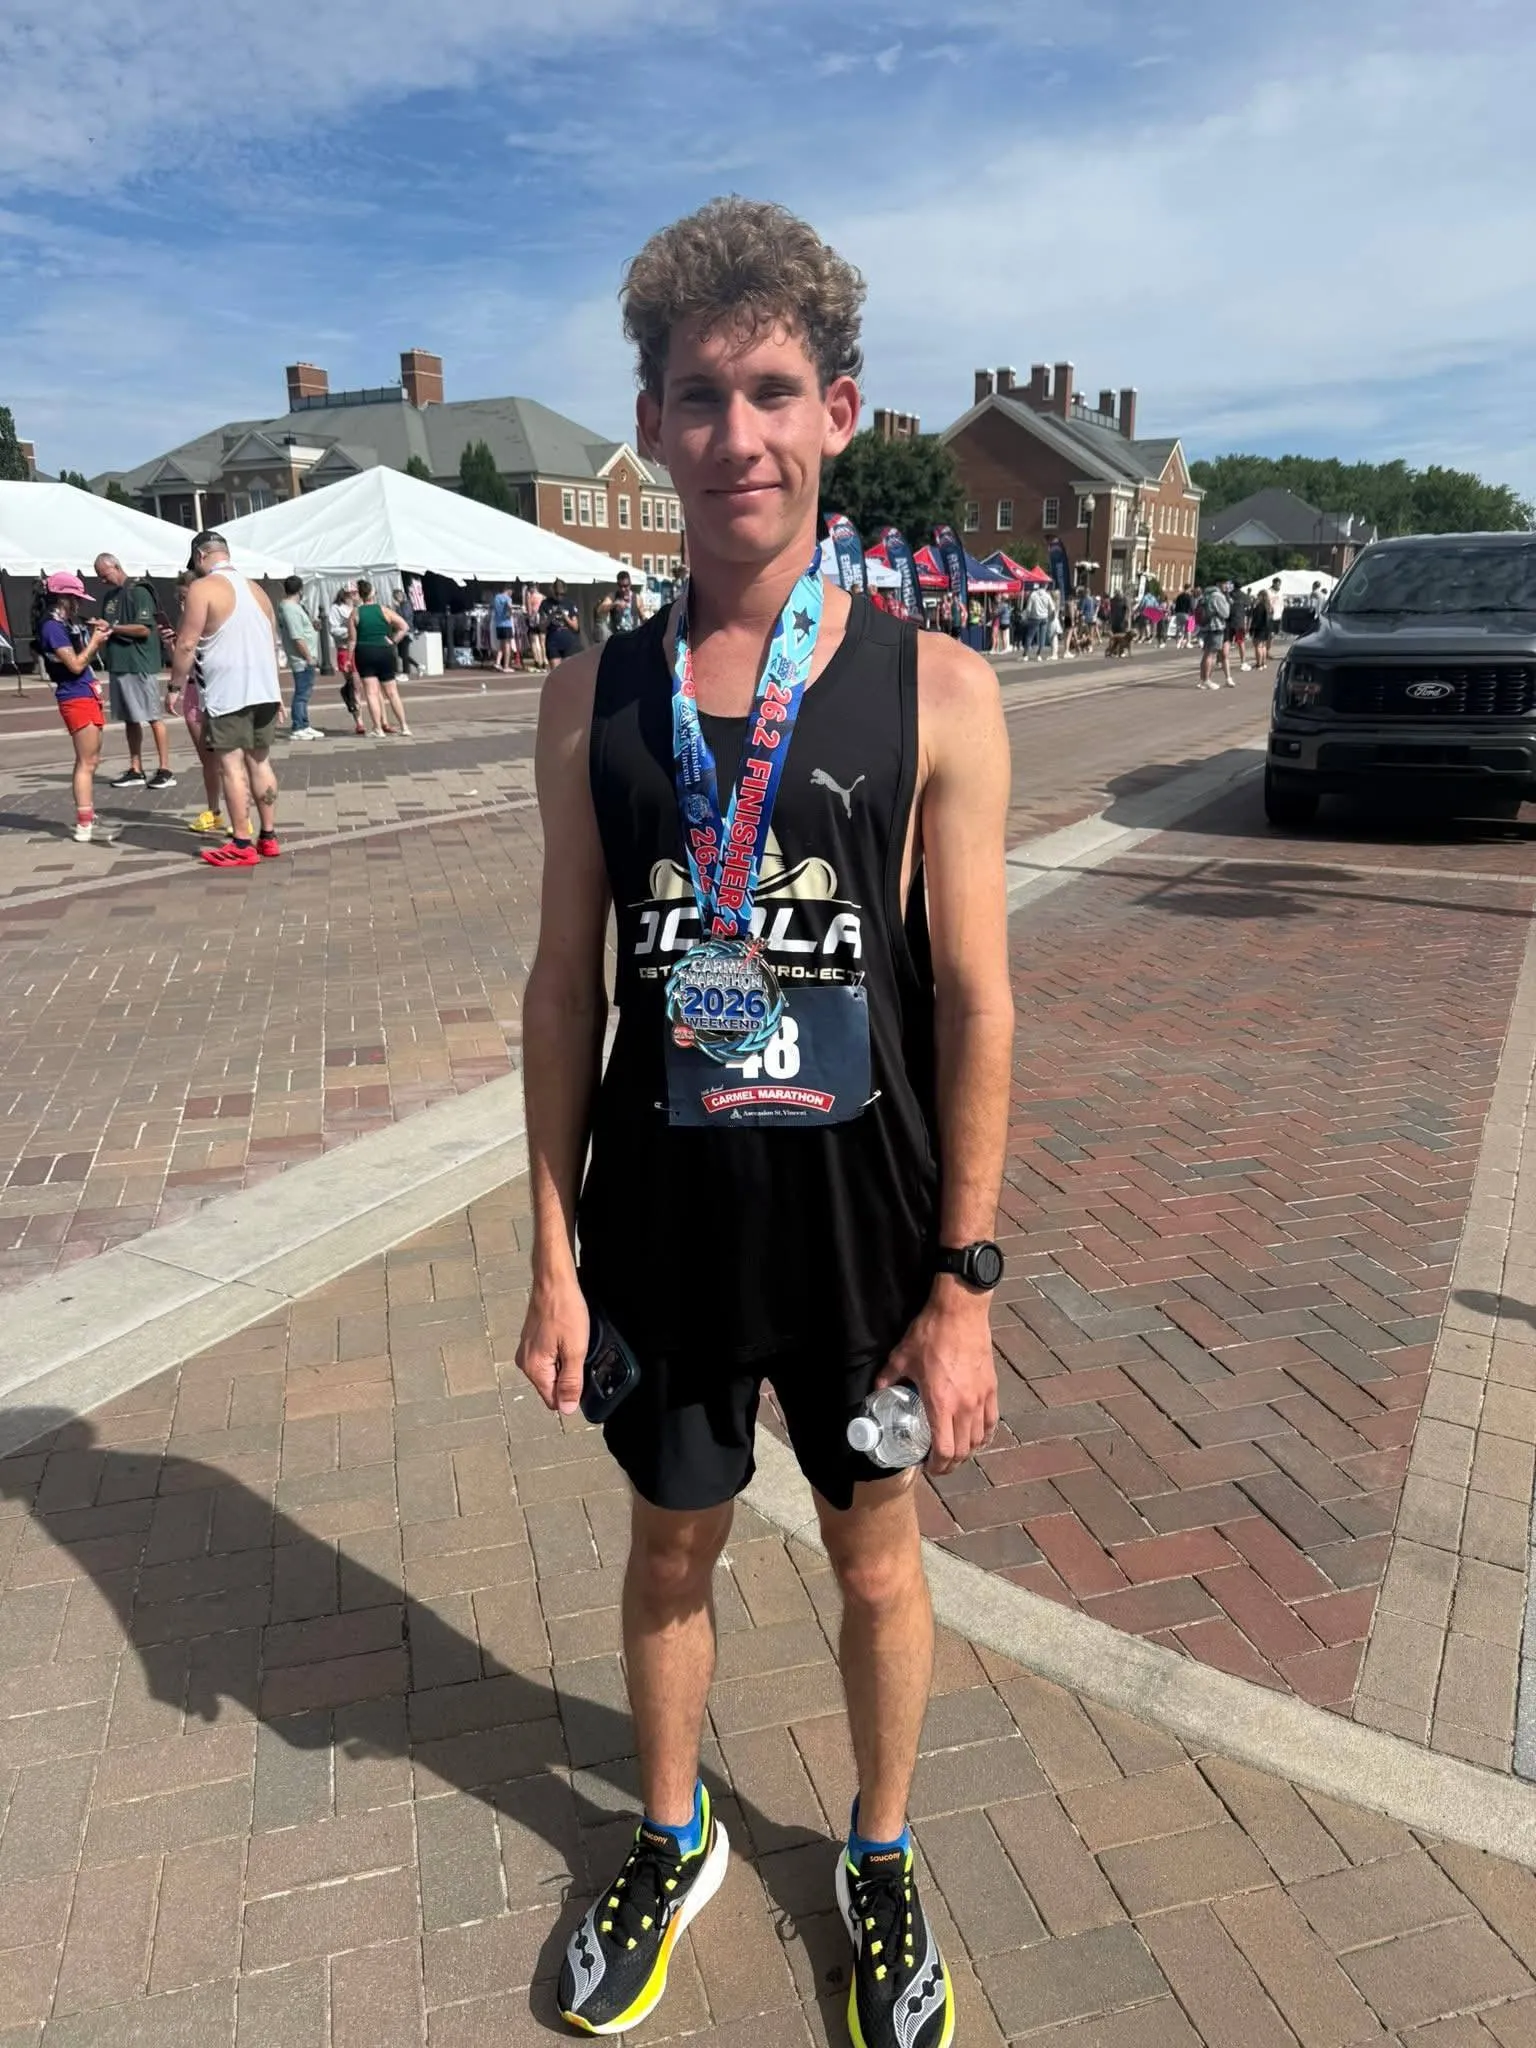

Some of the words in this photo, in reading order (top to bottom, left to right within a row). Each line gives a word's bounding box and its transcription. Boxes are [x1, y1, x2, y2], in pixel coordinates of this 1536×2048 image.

[752, 681, 793, 749] 26.2
[717, 758, 773, 910] FINISHER
[685, 972, 763, 989] MARATHON
[684, 986, 766, 1018] 2026
[685, 1017, 760, 1030] WEEKEND
[711, 1090, 757, 1107] CARMEL
[757, 1089, 825, 1106] MARATHON
[870, 1852, 901, 1862] saucony
